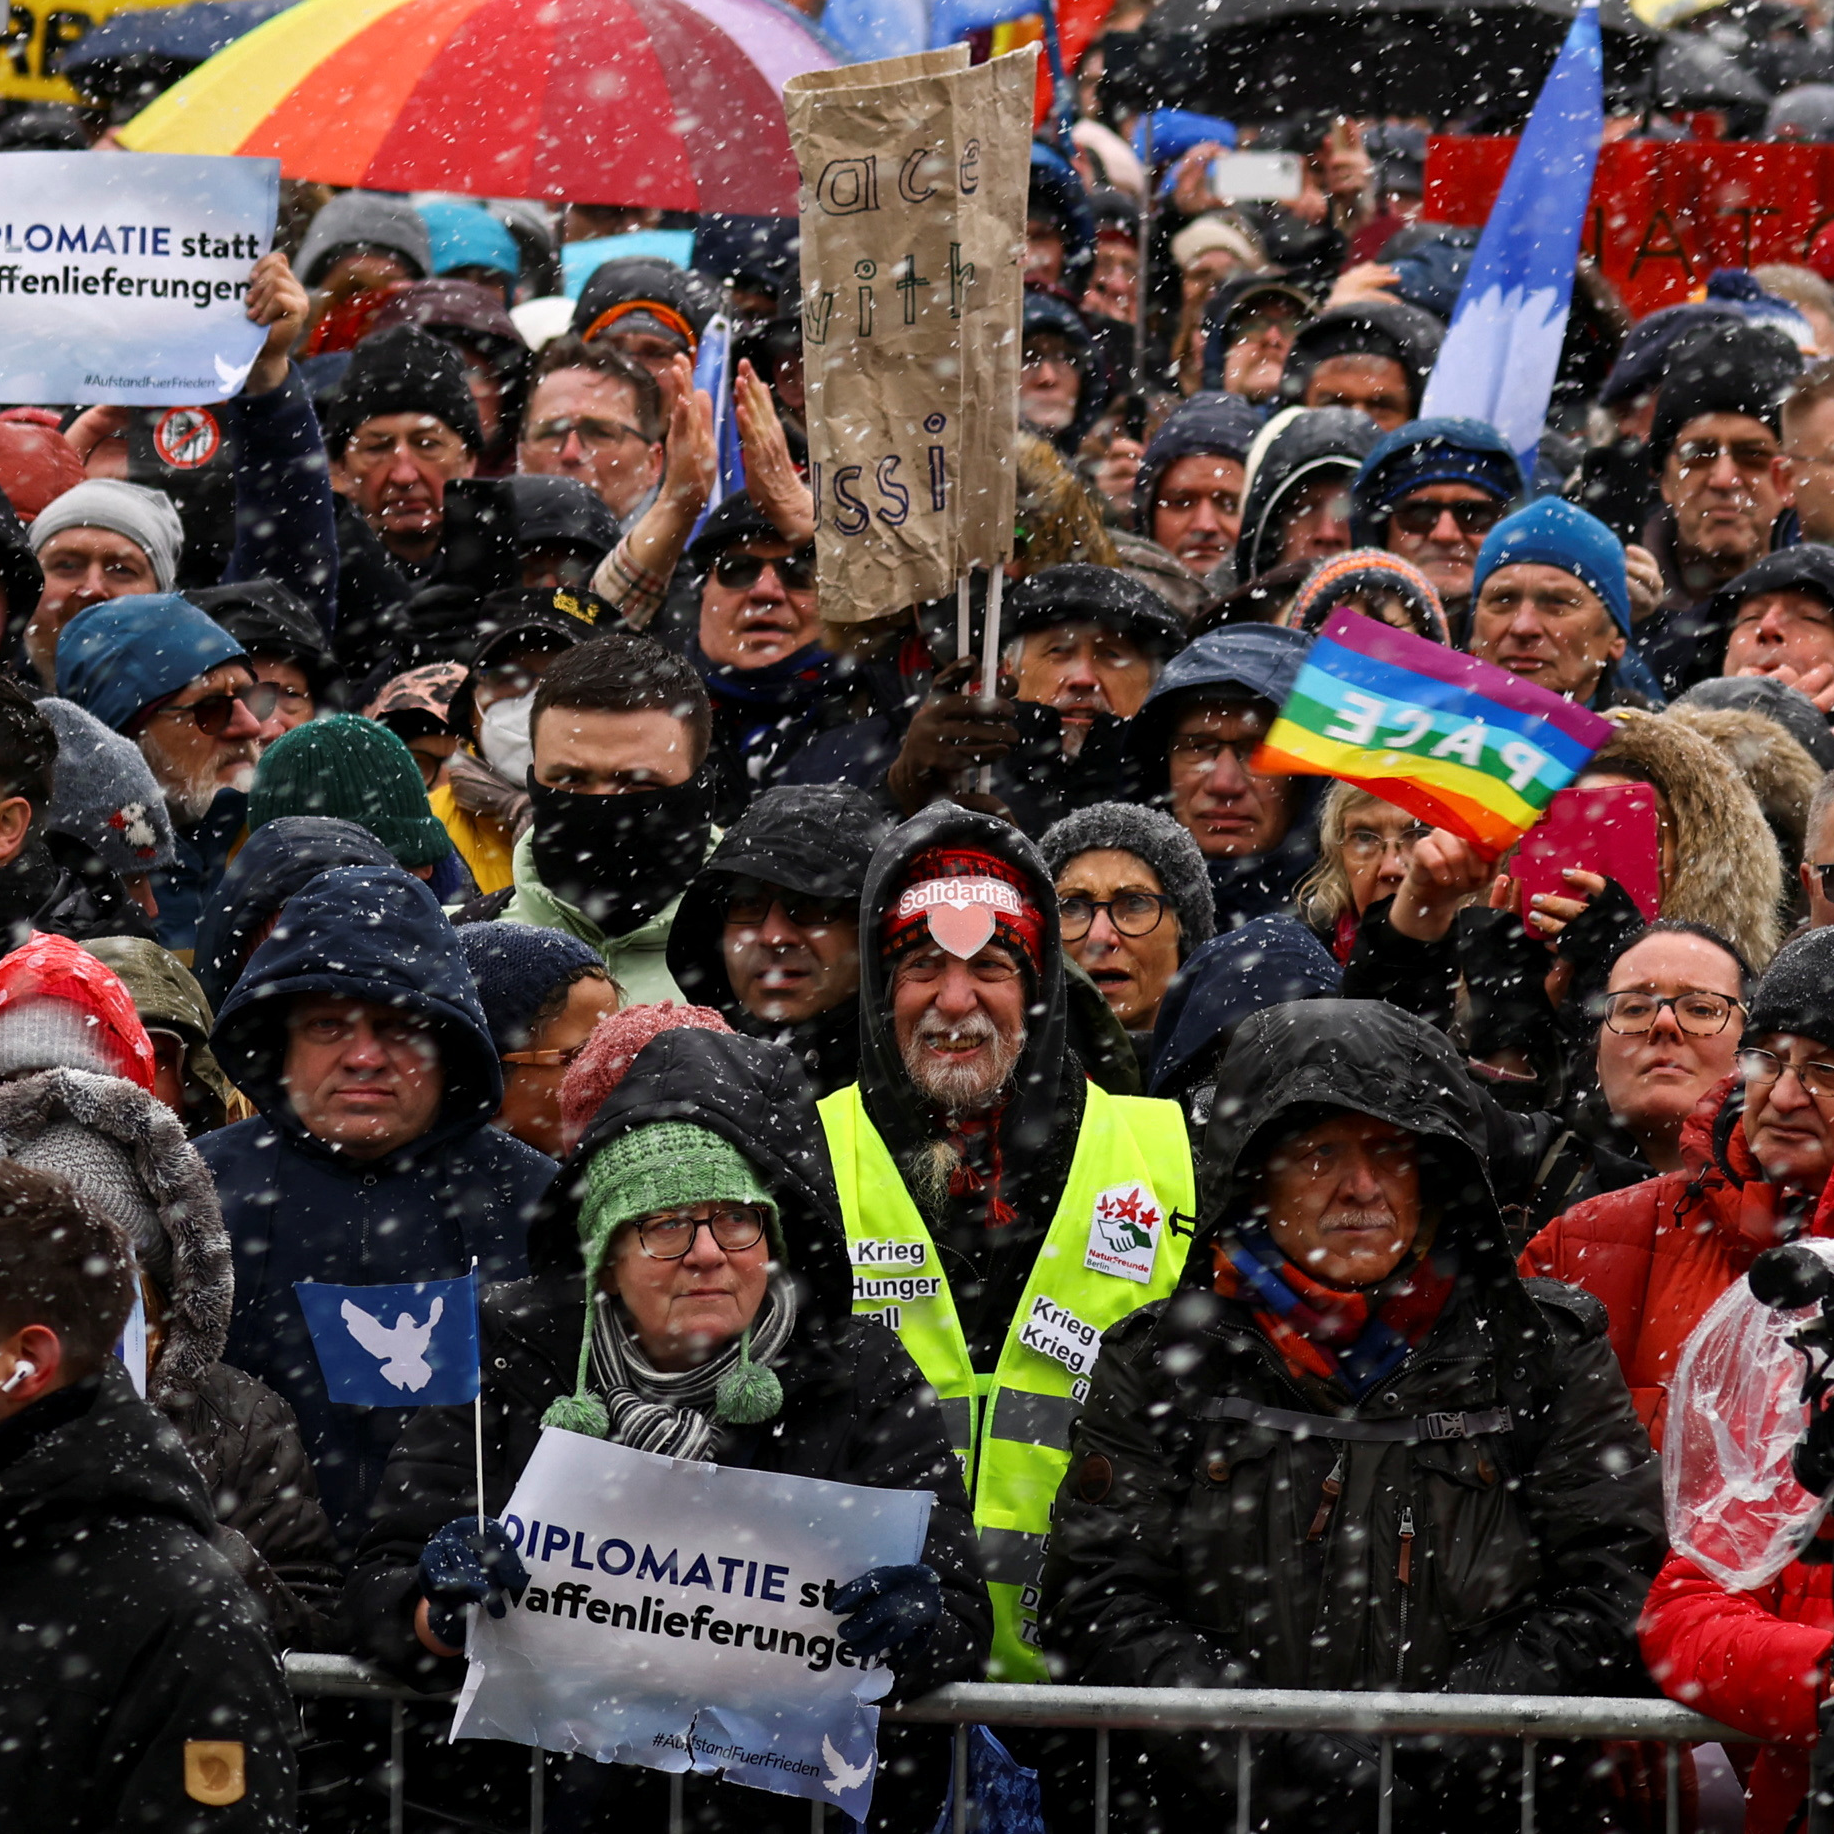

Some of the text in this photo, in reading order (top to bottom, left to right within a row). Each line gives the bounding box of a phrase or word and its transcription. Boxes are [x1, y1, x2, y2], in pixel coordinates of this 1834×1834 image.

[798, 138, 980, 216] ace
[181, 232, 260, 260] statt
[84, 373, 216, 390] #AufstandFuerFrieden
[901, 879, 1019, 913] Solidarität
[857, 1241, 926, 1267] Krieg
[1086, 1257, 1111, 1272] Berlin
[1032, 1296, 1097, 1343] Krieg
[1021, 1323, 1086, 1373] Krieg
[503, 1513, 791, 1603] DIPLOMATIE
[507, 1573, 888, 1673] affenlieferunge
